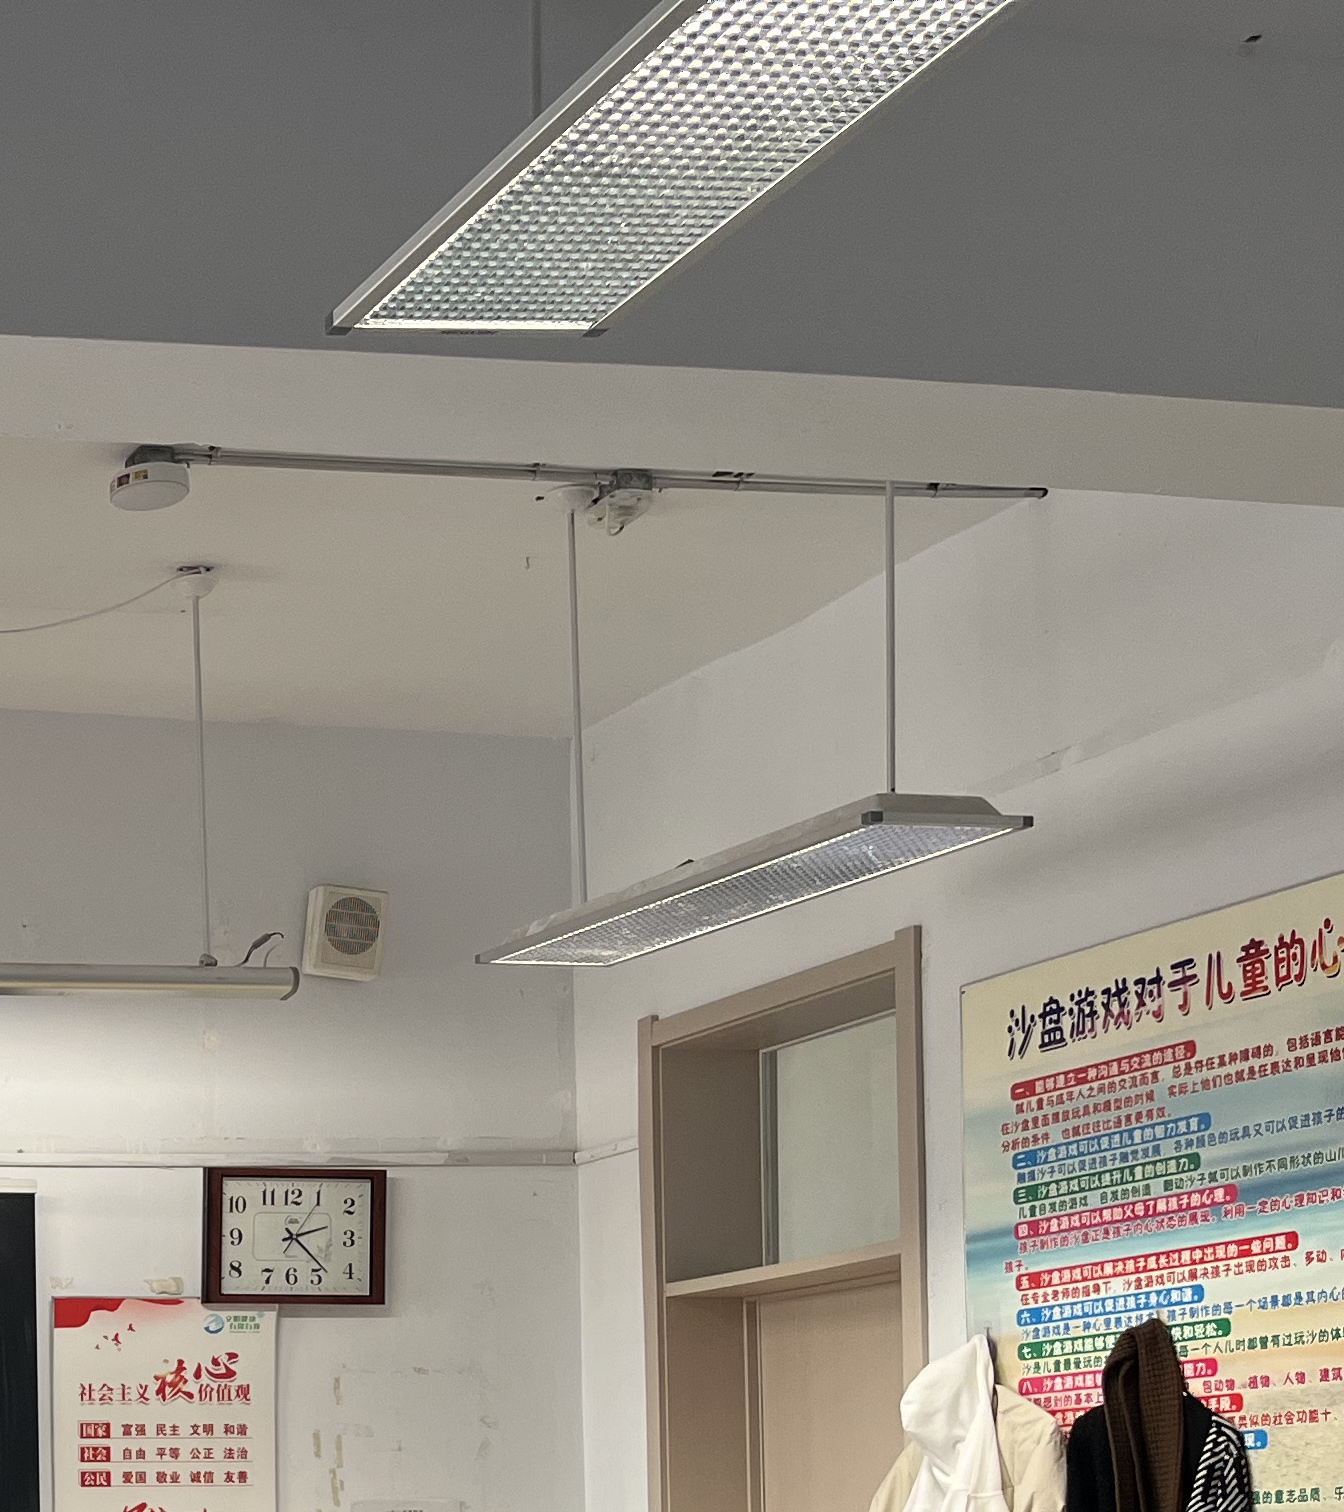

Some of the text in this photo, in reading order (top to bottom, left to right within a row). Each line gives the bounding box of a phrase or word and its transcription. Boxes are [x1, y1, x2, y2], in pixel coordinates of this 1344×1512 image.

[1007, 917, 1344, 1061] 沙盘游戏对于儿童的心
[228, 1195, 356, 1215] 10 2
[262, 1188, 321, 1206] 11 12 1
[229, 1227, 355, 1247] 9 3
[228, 1260, 354, 1280] 8 4
[262, 1267, 323, 1285] 7 6 5
[1022, 1334, 1119, 1359] 七、沙盒游戏能够使
[1022, 1327, 1344, 1375] 沙是儿童最爱玩的 每一个人儿时都曾有过玩沙的体
[78, 1352, 252, 1402] 社会主义核心价值观
[1180, 1362, 1213, 1378] 能力。
[81, 1423, 249, 1438] 国家 富强 民主 文明 和谐
[83, 1447, 249, 1461] 社会 自由 平等 公正 法治
[83, 1471, 249, 1486] 公民 爱国 敬业 诚信 友善
